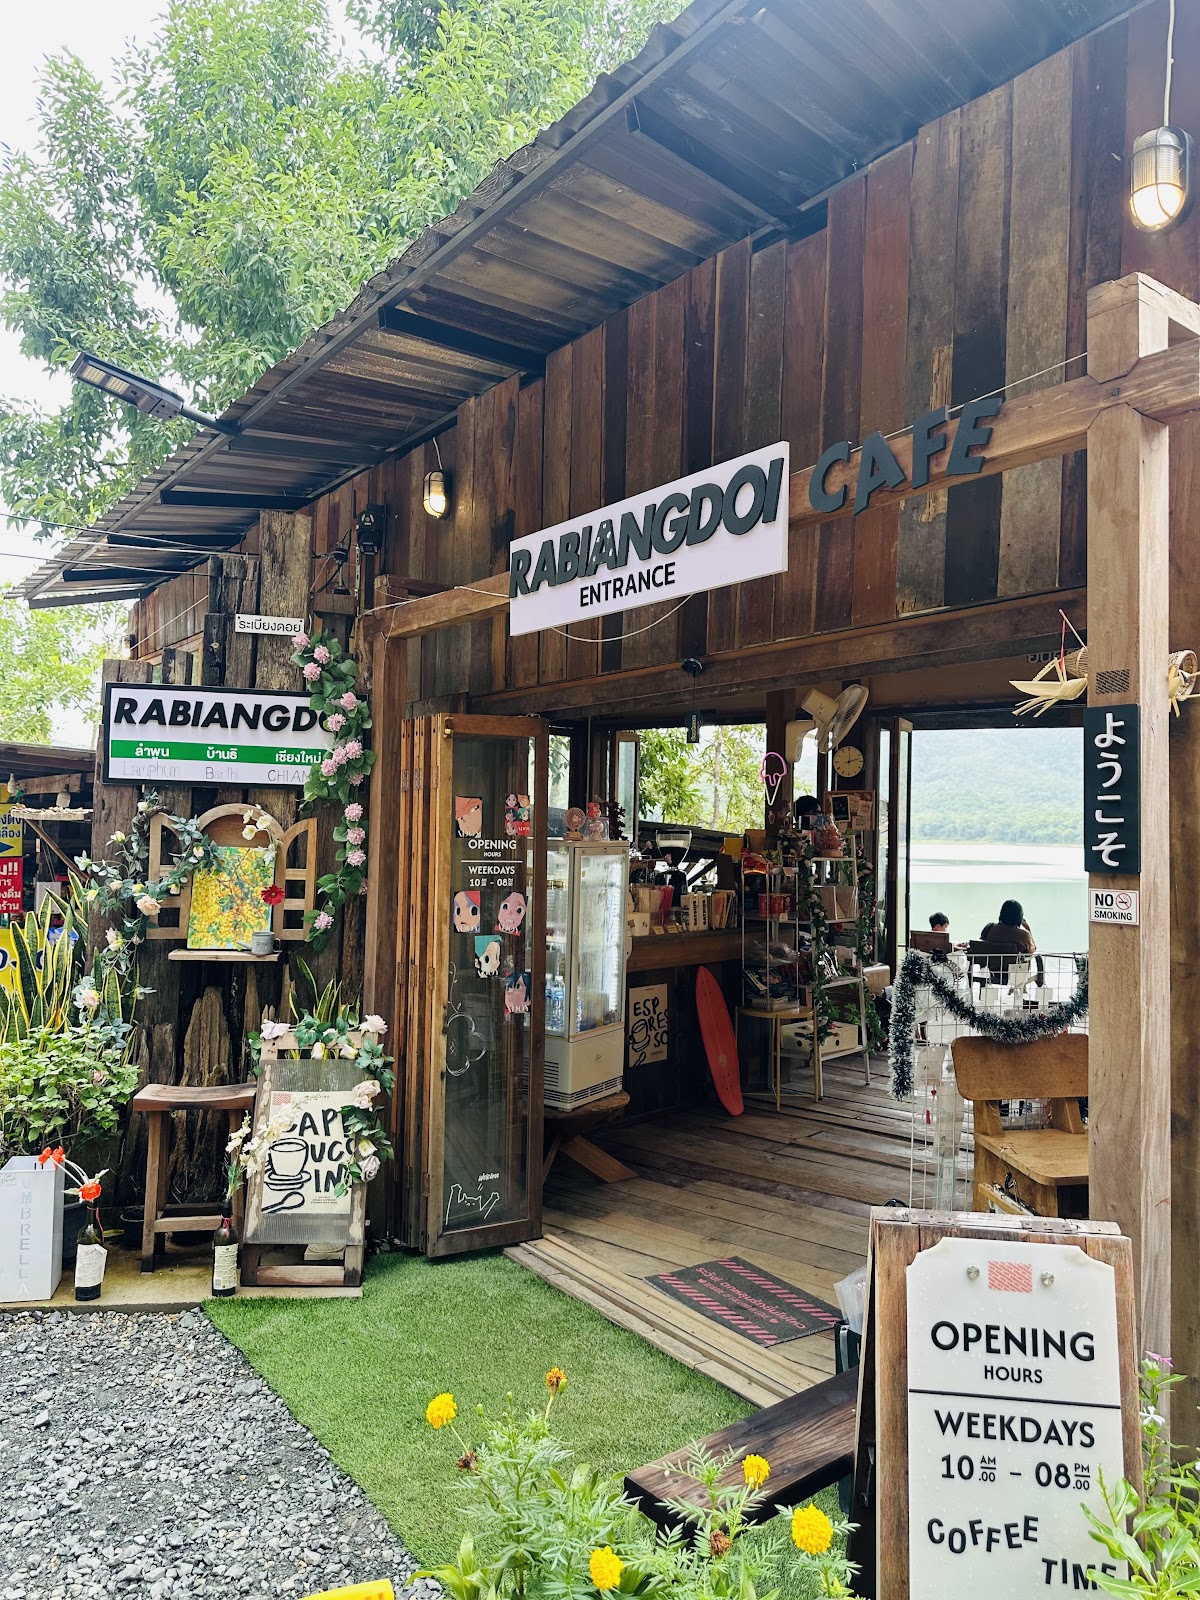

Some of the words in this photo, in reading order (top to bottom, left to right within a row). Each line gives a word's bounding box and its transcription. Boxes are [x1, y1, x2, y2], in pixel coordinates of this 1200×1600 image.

[808, 397, 1003, 516] CAFE
[508, 457, 785, 599] RABIANGDOI
[579, 561, 676, 608] ENTRANCE
[135, 743, 170, 759] ลำพูน
[206, 745, 238, 760] บ้านธิ
[275, 750, 322, 764] เชียงใหม่
[1091, 712, 1126, 867] ようこそ
[468, 839, 517, 850] OPENING
[468, 865, 516, 875] WEEKDAYS
[469, 878, 481, 887] 10
[496, 878, 508, 887] 08
[1095, 893, 1114, 908] NO
[1094, 910, 1132, 922] SMOKING
[633, 996, 660, 1017] ESP
[930, 1320, 1095, 1362] OPENING
[984, 1365, 1043, 1384] HOURS
[933, 1409, 1096, 1448] WEEKDAYS
[941, 1453, 975, 1480] 10
[980, 1455, 997, 1466] AM
[1035, 1461, 1071, 1489] 08
[1074, 1463, 1090, 1474] PM
[927, 1514, 1039, 1554] COFFEE
